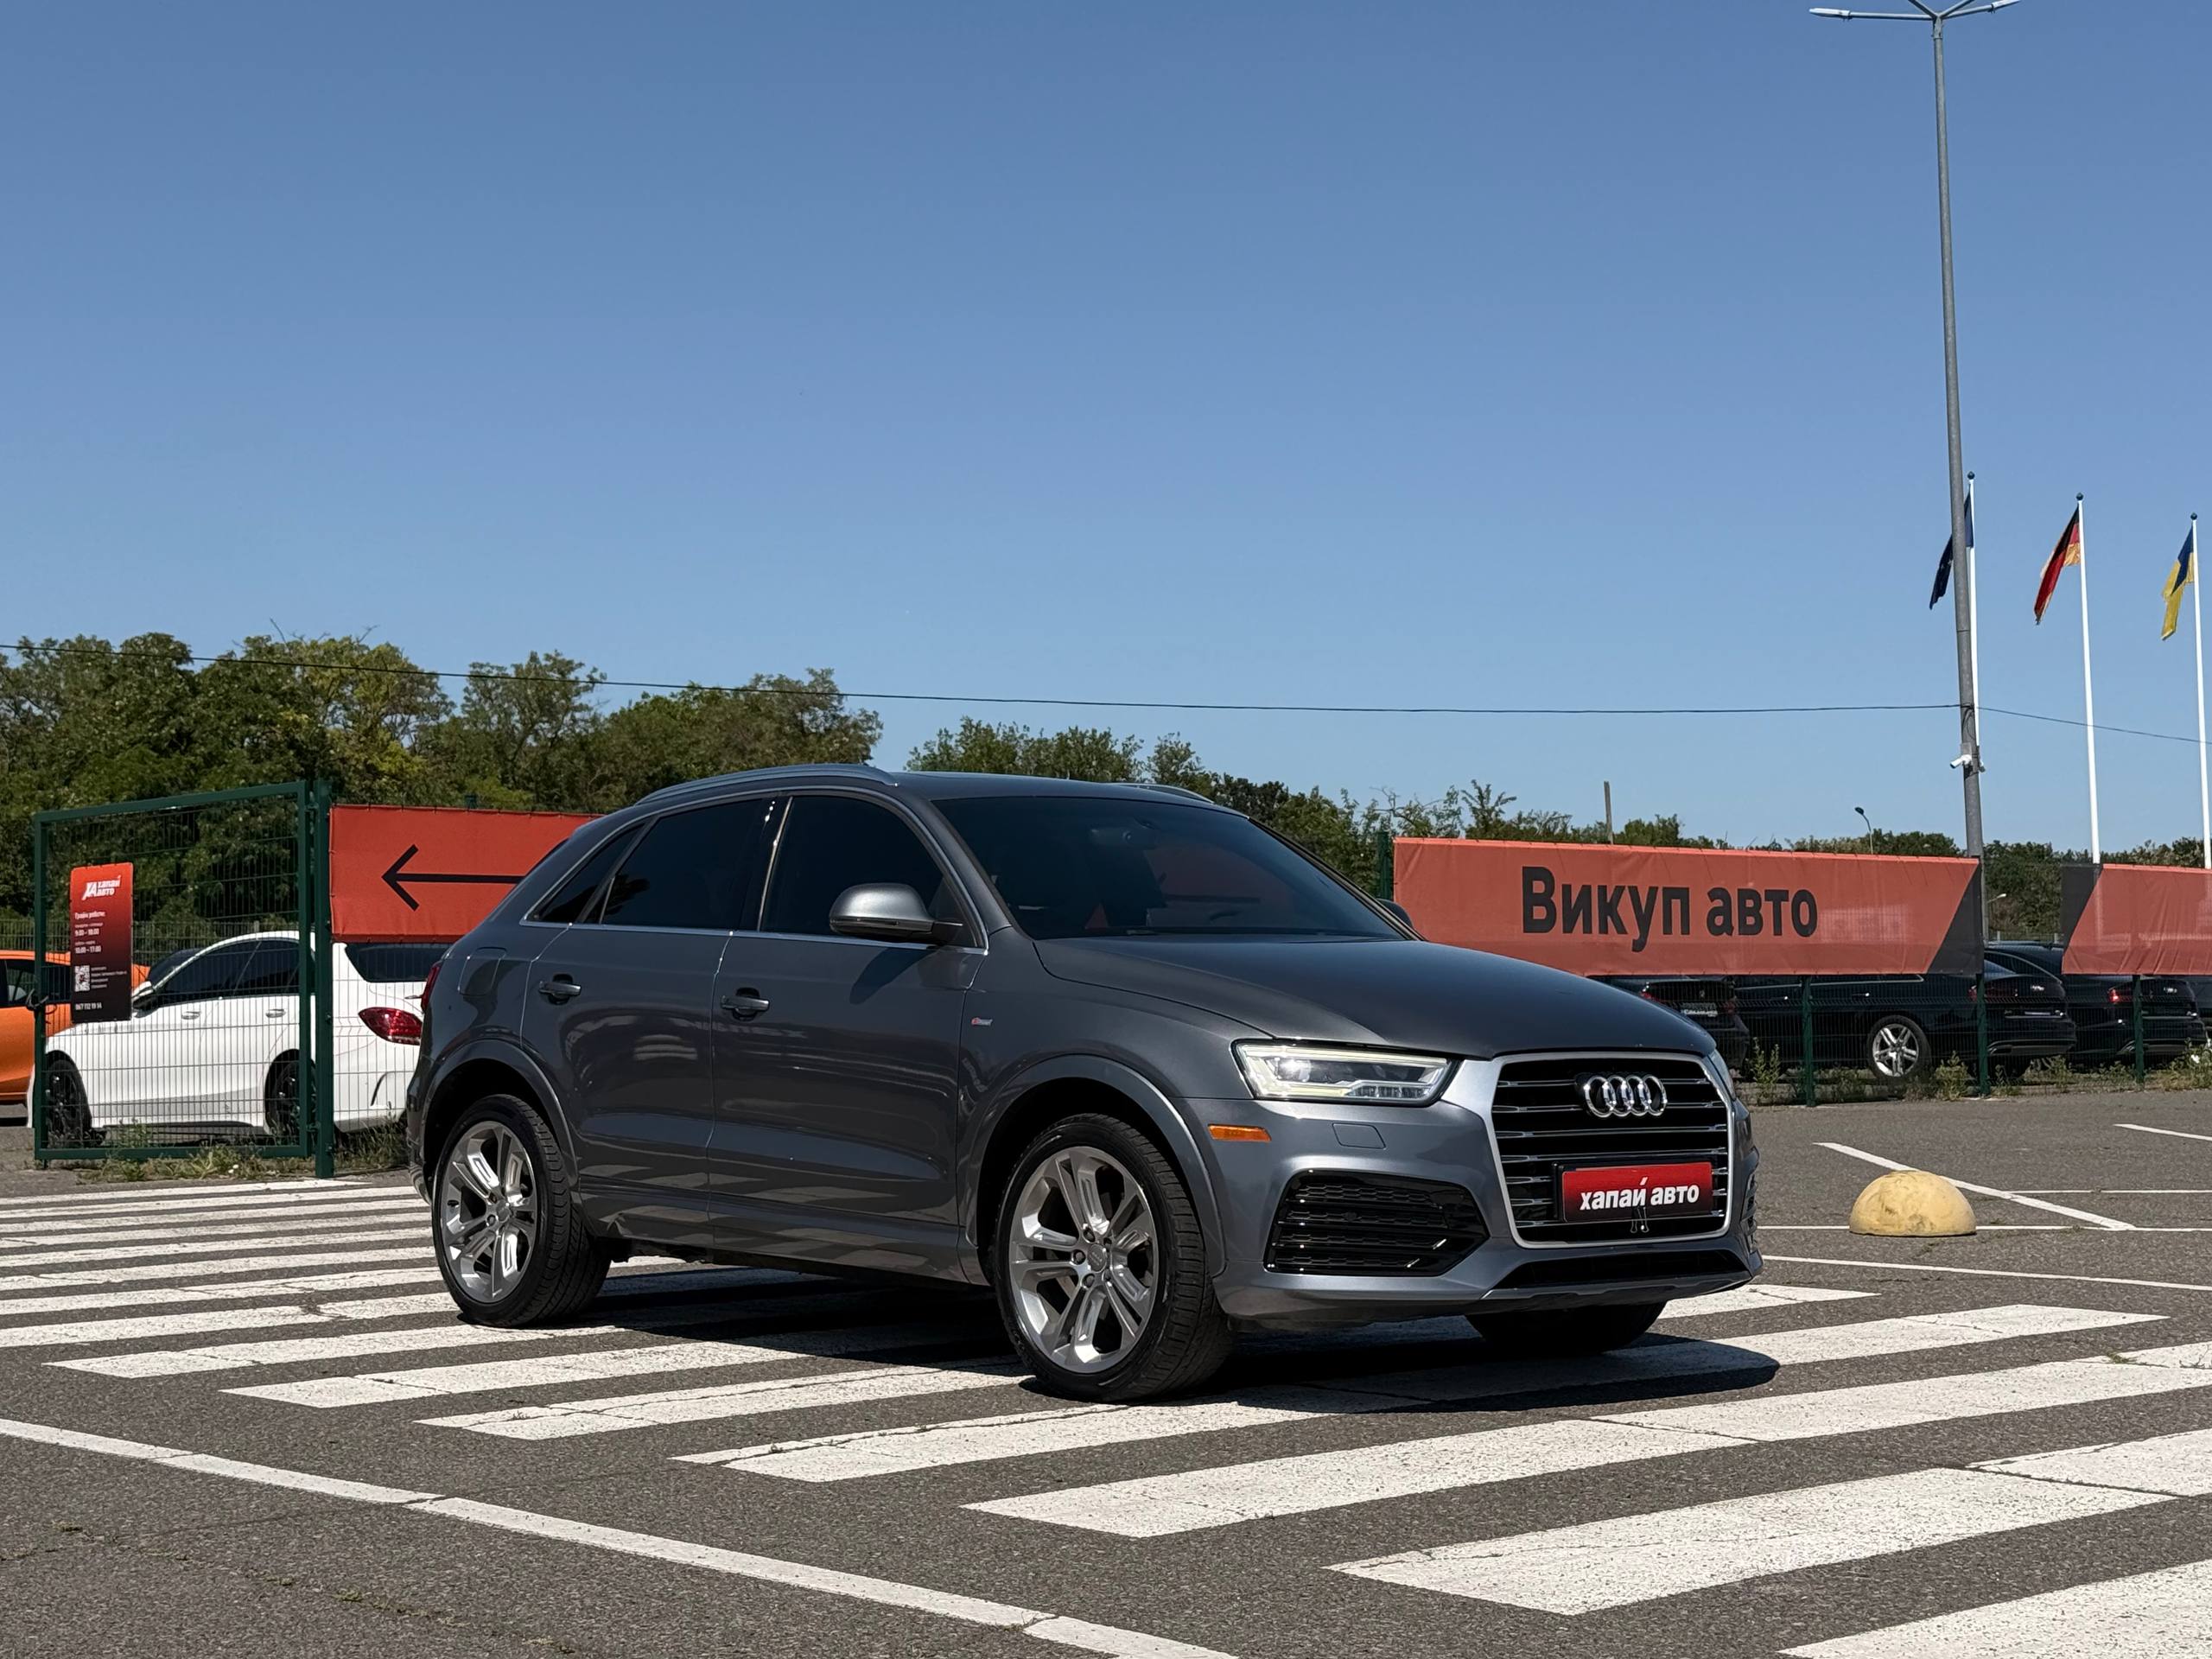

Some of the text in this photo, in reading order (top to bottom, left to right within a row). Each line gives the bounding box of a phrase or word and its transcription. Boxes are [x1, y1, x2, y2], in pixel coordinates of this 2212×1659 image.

[1522, 866, 1818, 953] Викуп авто
[1580, 1177, 1700, 1211] хапай авто
